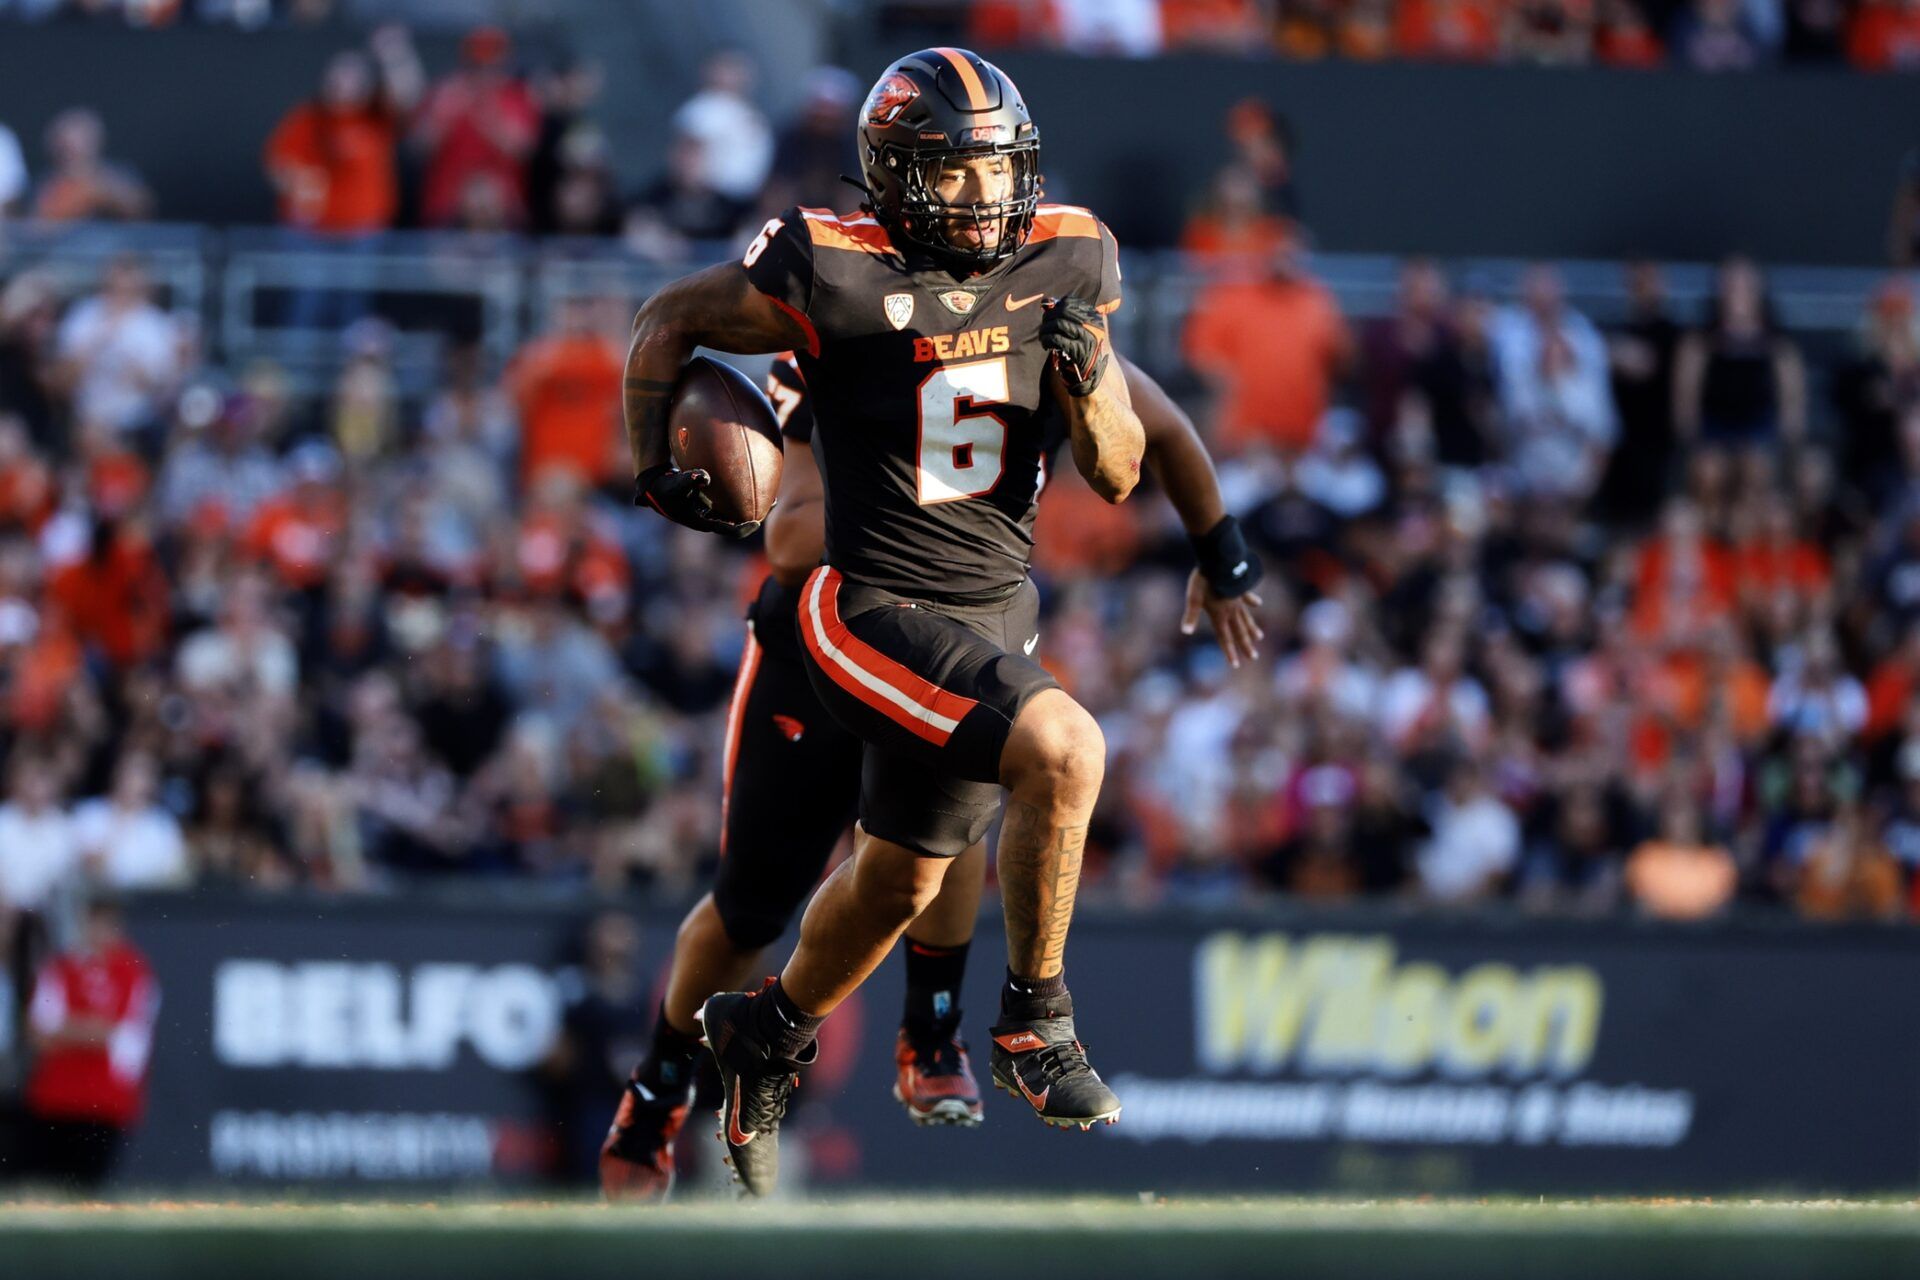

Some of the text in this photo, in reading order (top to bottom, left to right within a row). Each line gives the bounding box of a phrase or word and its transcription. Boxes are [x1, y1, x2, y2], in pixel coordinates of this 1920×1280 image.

[742, 217, 786, 269] 6
[892, 310, 906, 323] 12
[912, 325, 1010, 363] BEAVS
[915, 356, 1010, 506] 6
[214, 959, 584, 1069] BELFO
[1195, 934, 1603, 1077] Wilson
[1010, 1034, 1036, 1046] ALPHA
